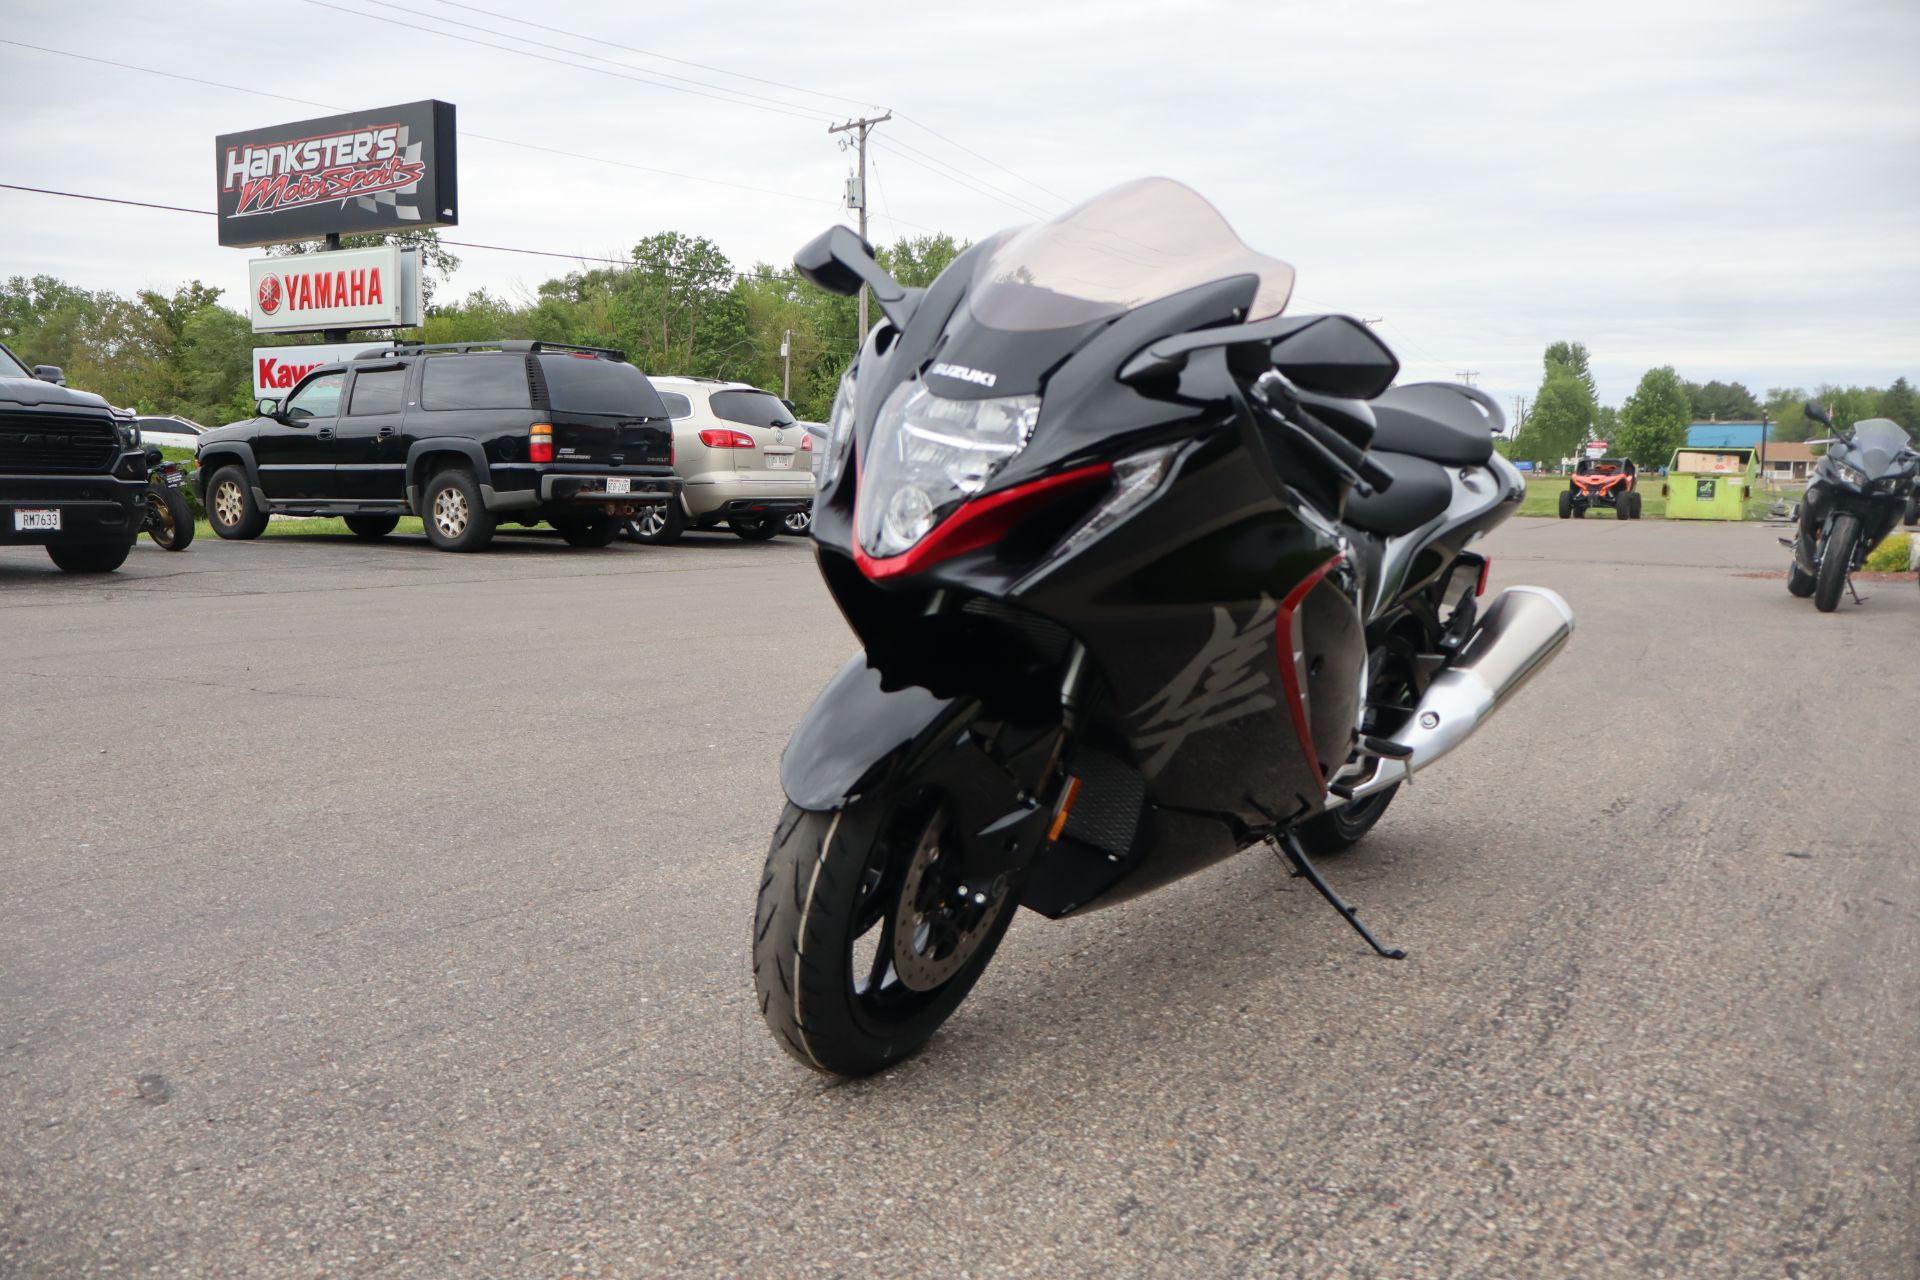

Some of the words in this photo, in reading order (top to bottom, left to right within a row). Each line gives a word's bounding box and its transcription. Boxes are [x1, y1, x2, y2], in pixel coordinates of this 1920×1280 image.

[284, 266, 383, 311] YAMAHA
[932, 362, 997, 387] SUZUKI
[23, 514, 58, 527] RM7633
